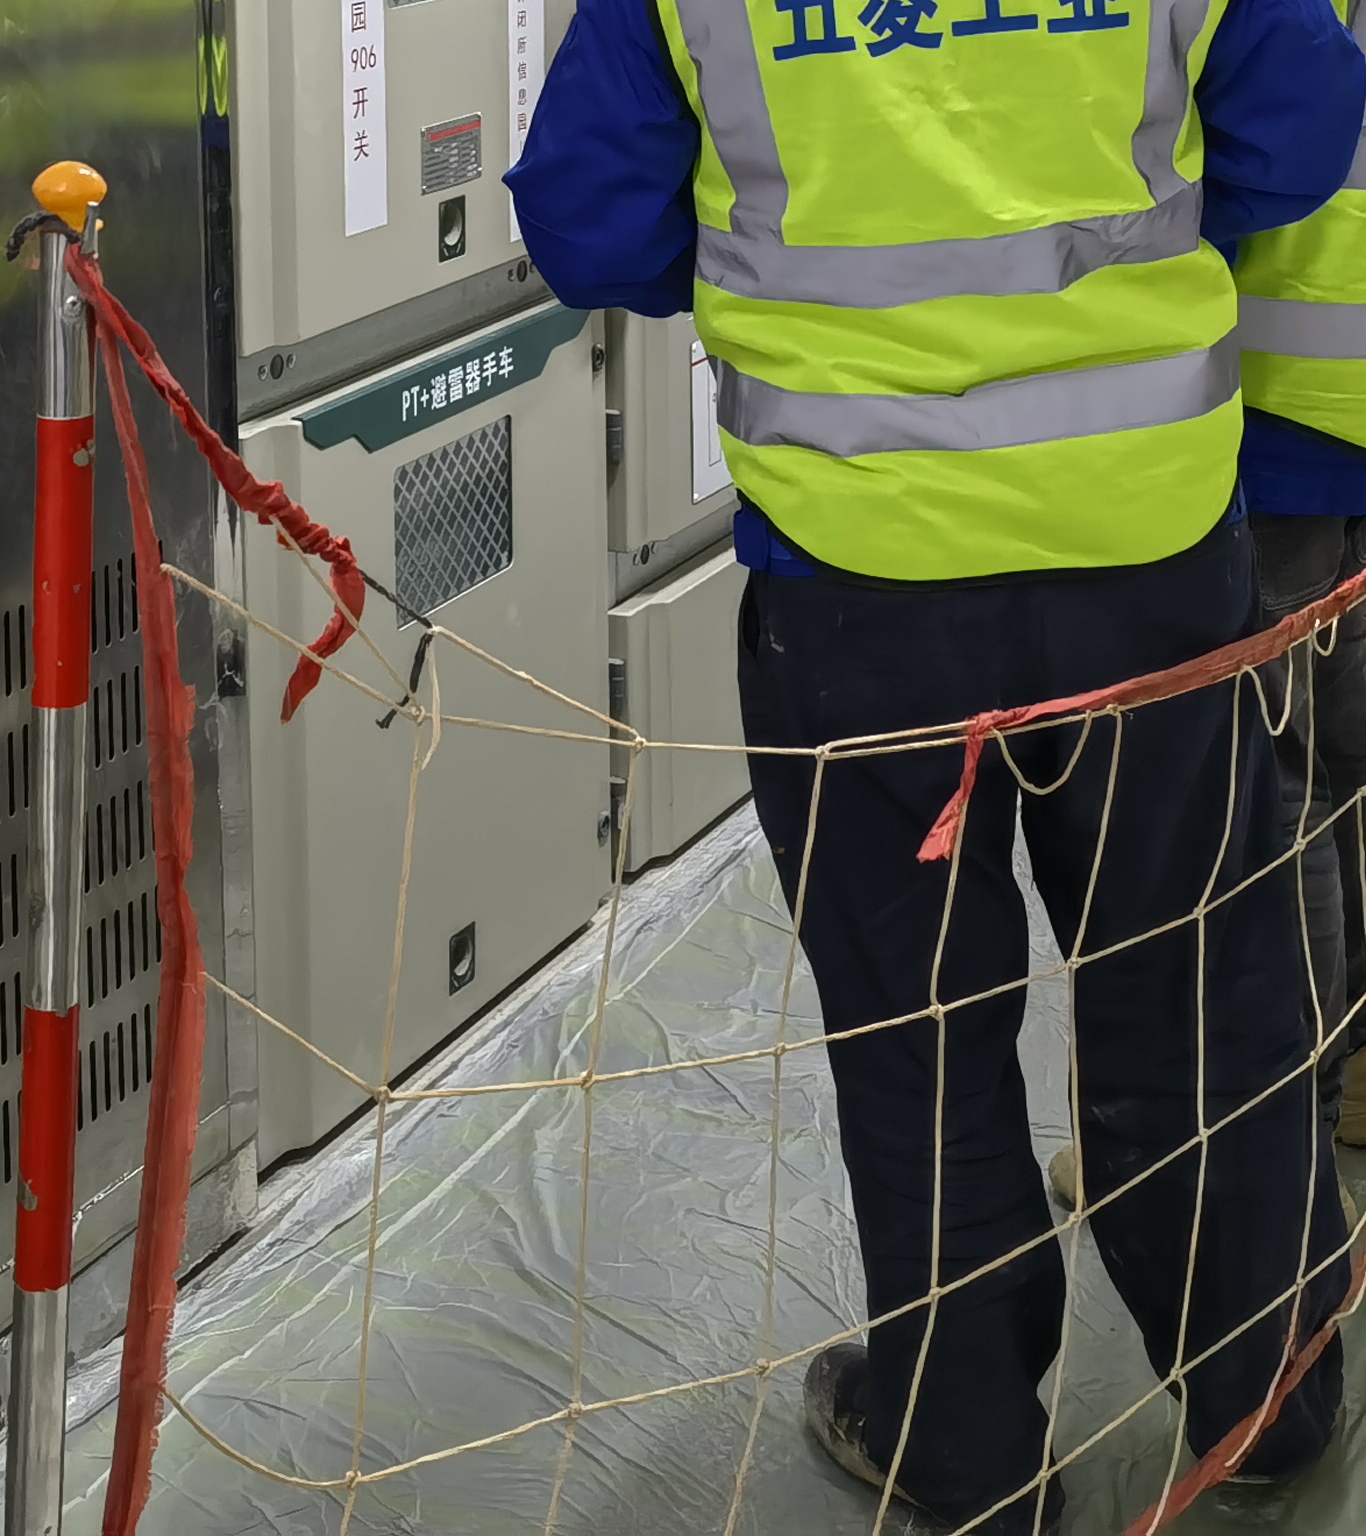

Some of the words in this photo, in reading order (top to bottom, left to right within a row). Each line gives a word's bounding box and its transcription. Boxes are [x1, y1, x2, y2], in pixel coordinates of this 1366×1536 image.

[402, 345, 515, 421] PT+避雷器手车
